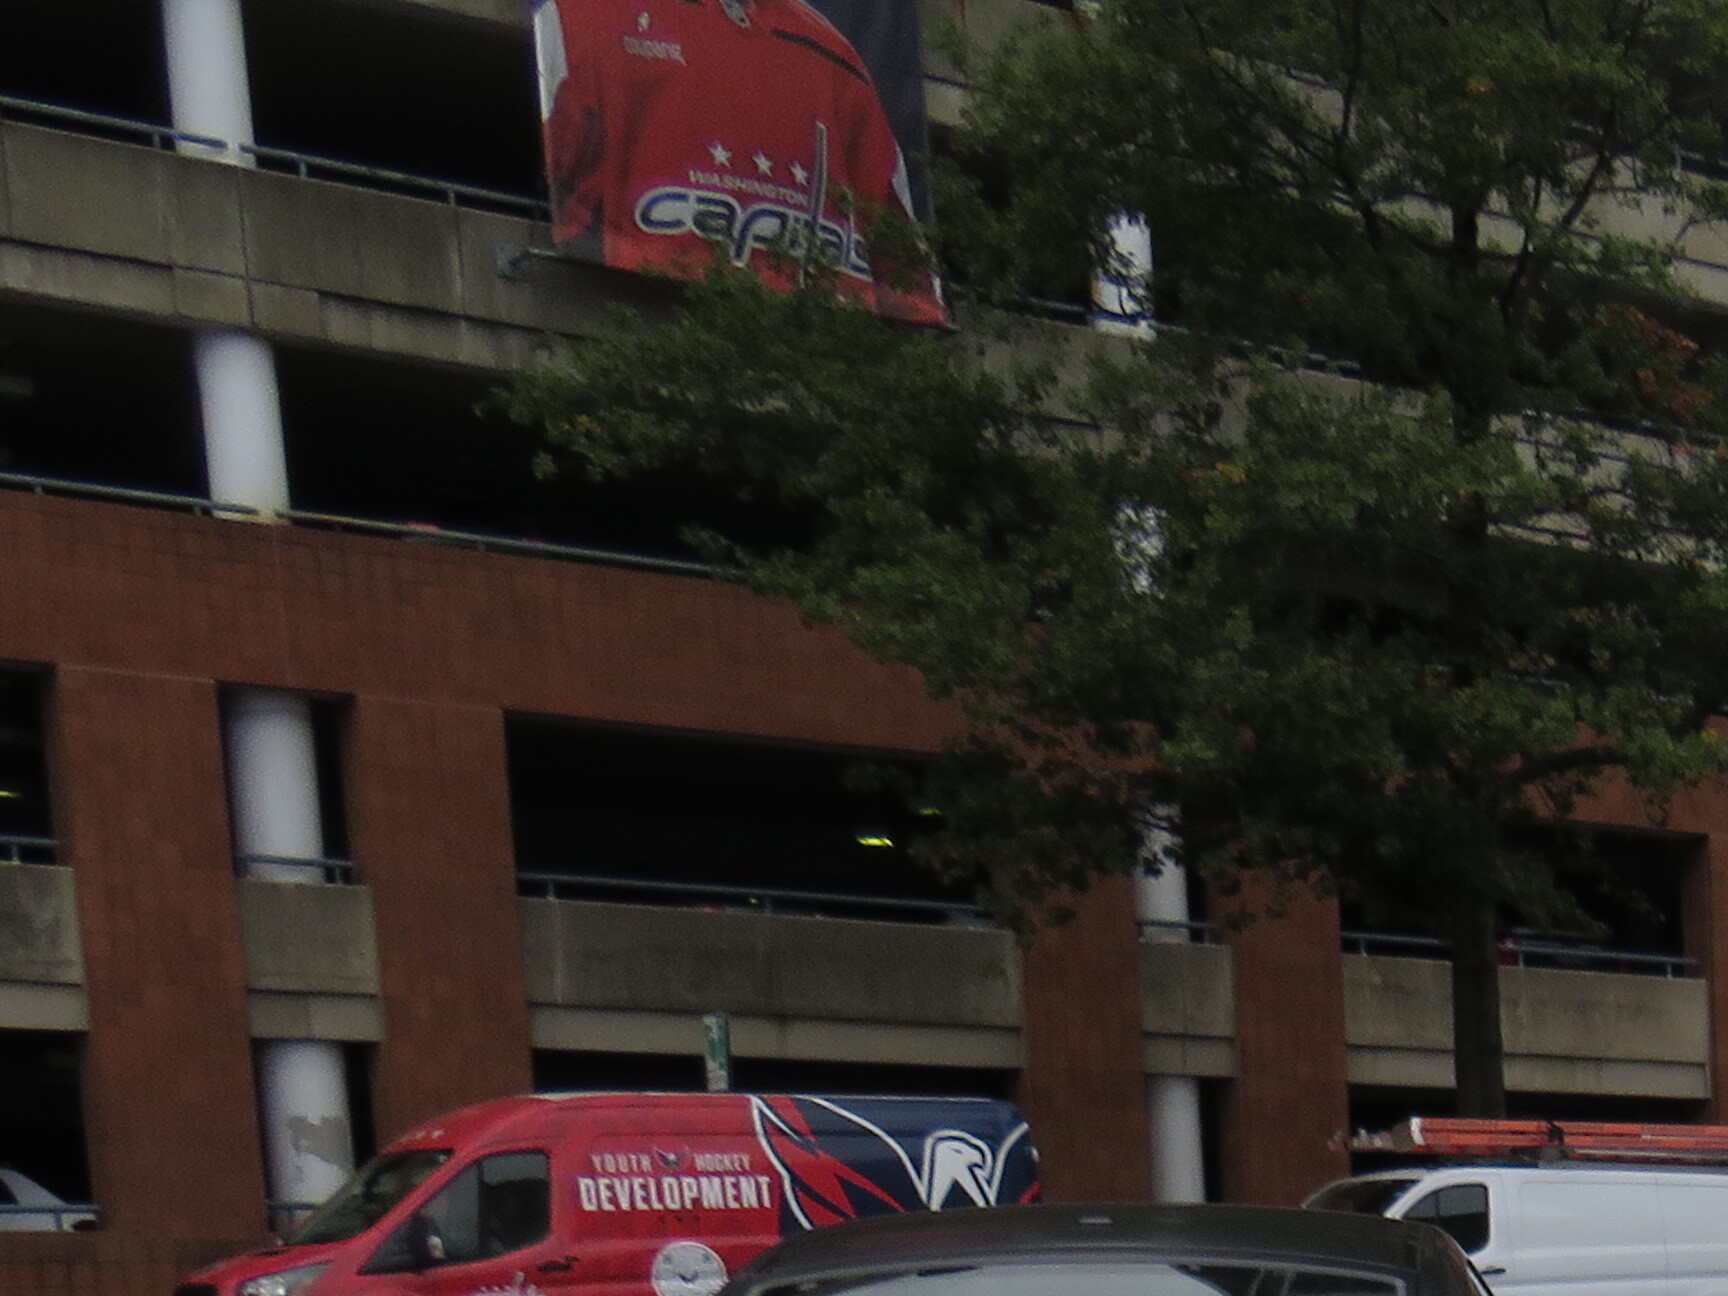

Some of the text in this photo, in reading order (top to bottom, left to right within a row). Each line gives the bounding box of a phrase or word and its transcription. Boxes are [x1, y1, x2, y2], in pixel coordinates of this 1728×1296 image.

[689, 170, 808, 205] WASHINGTON
[591, 1152, 750, 1173] YOUTH HOCKEY
[577, 1175, 772, 1211] DEVELOPMENT
